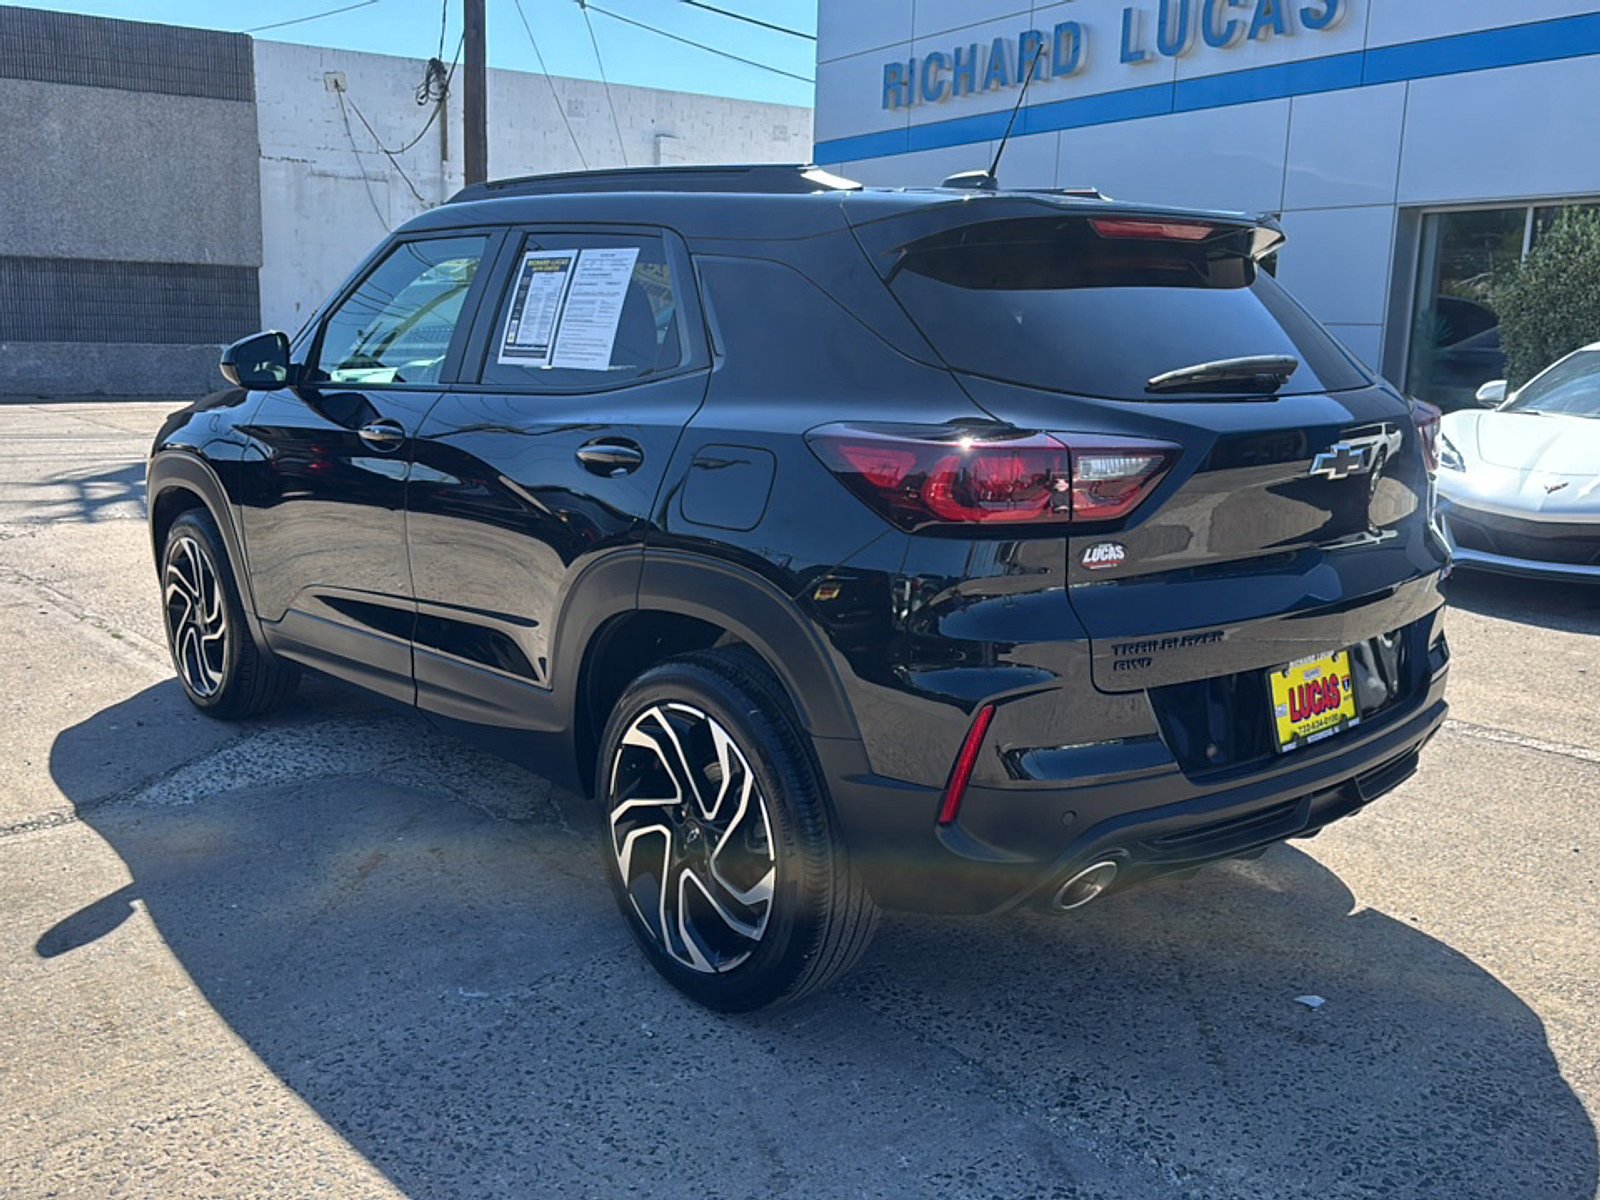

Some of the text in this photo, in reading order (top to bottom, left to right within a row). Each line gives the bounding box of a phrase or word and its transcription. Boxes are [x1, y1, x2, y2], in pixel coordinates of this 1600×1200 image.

[881, 20, 1085, 110] RICHARD
[1081, 544, 1125, 563] LUCAS
[1111, 630, 1225, 656] TRAILBLAZER
[1288, 673, 1341, 723] LUCAS
